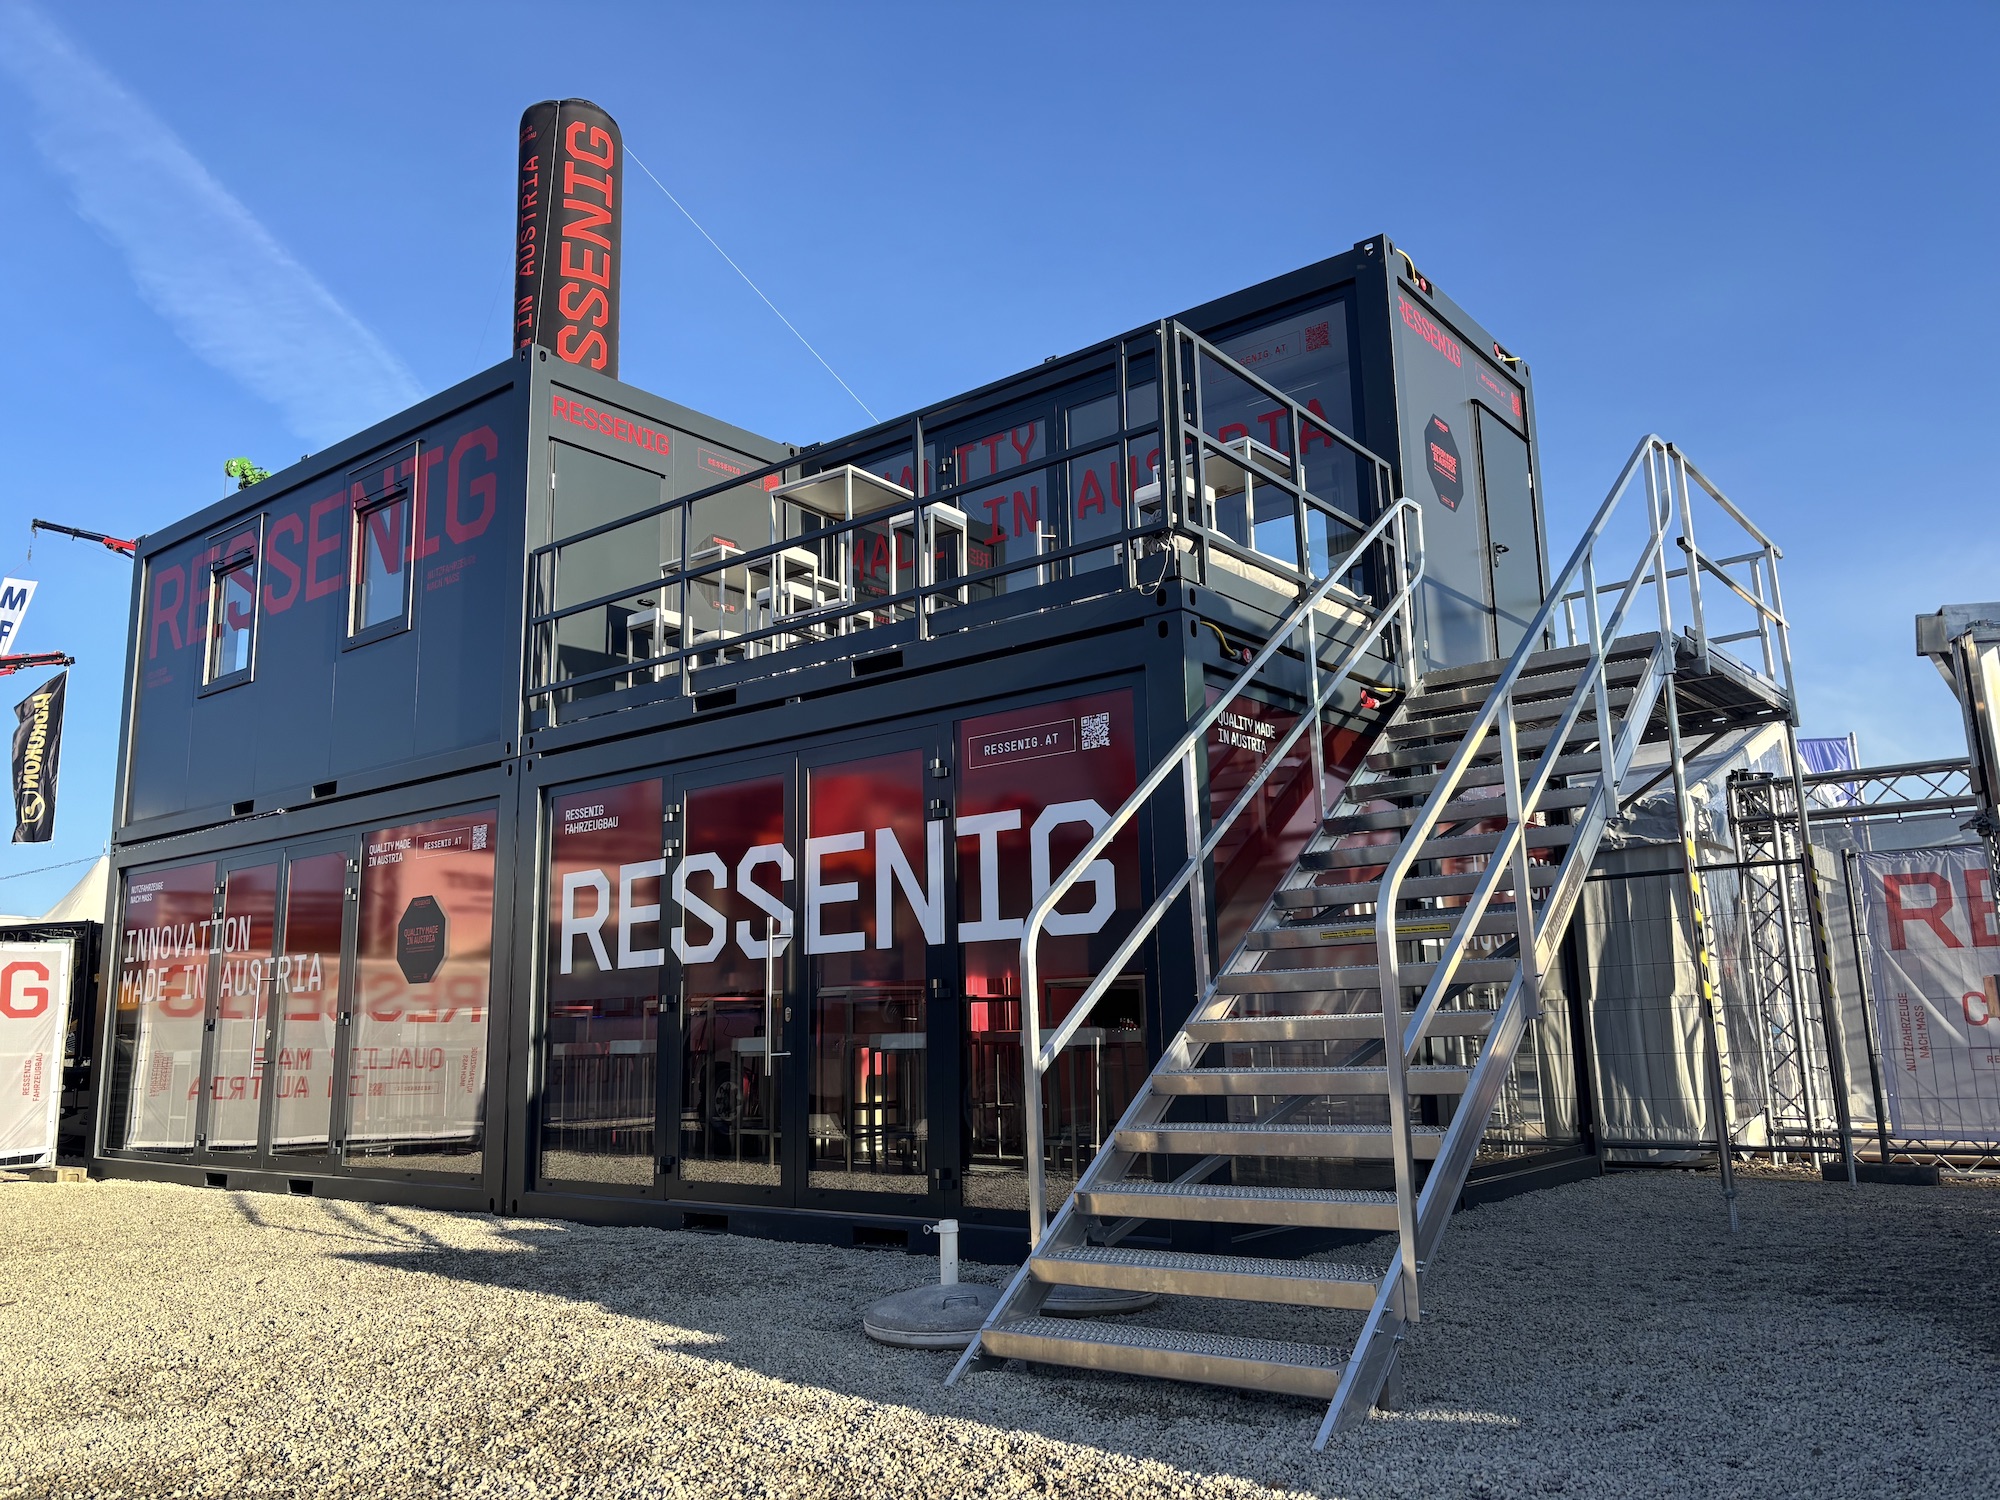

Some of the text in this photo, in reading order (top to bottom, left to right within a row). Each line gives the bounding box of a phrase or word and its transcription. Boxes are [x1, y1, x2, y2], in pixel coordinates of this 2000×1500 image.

[518, 154, 539, 276] AUSTRIA
[556, 120, 615, 370] SSENIG
[516, 295, 534, 332] IN
[1398, 295, 1462, 369] RESSENIG
[552, 394, 671, 457] RESSENIG
[982, 485, 1038, 546] IN
[148, 424, 499, 660] RESSENIG
[983, 731, 1060, 757] RESSENIG.AT
[1217, 710, 1276, 740] QUALITY MADE
[1217, 727, 1267, 754] IN AUSTRIA
[564, 803, 605, 821] RESSENIG
[564, 815, 619, 836] FAHRZEUGBAU
[368, 836, 462, 855] QUALITY MADE RESSENIG.AT
[368, 851, 403, 867] IN AUSTRIA
[130, 893, 153, 904] NACH MASS
[558, 798, 1118, 976] RESSENIG
[124, 914, 252, 964] INNOVATION
[0, 961, 50, 1019] G
[121, 952, 322, 1004] MADE IN AUSTRIA
[1897, 992, 1917, 1071] NUTZFAHRZEUGE
[1914, 1005, 1930, 1059] NACH MASS
[22, 1059, 32, 1096] RESSENIG
[32, 1052, 43, 1102] FAHRZEUGBAU
